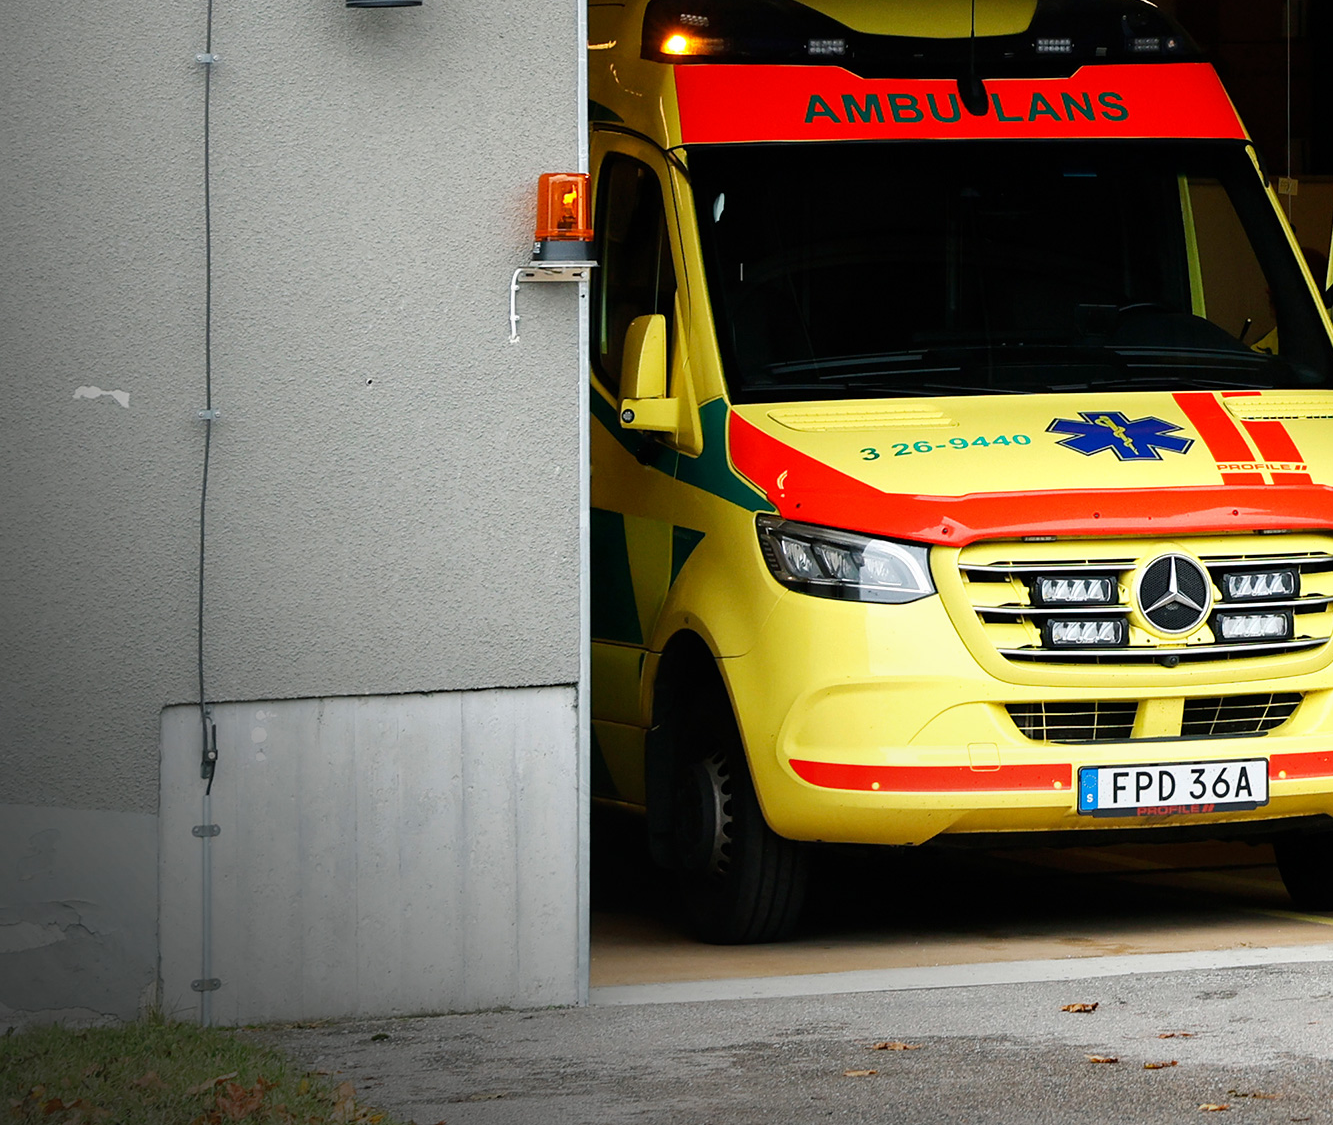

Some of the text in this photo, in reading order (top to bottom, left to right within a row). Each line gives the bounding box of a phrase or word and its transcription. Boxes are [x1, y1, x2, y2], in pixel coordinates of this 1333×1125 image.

[804, 92, 1129, 124] AMBULANS
[860, 434, 1031, 461] 3 26-9440
[1086, 766, 1253, 804] S FPD 36A
